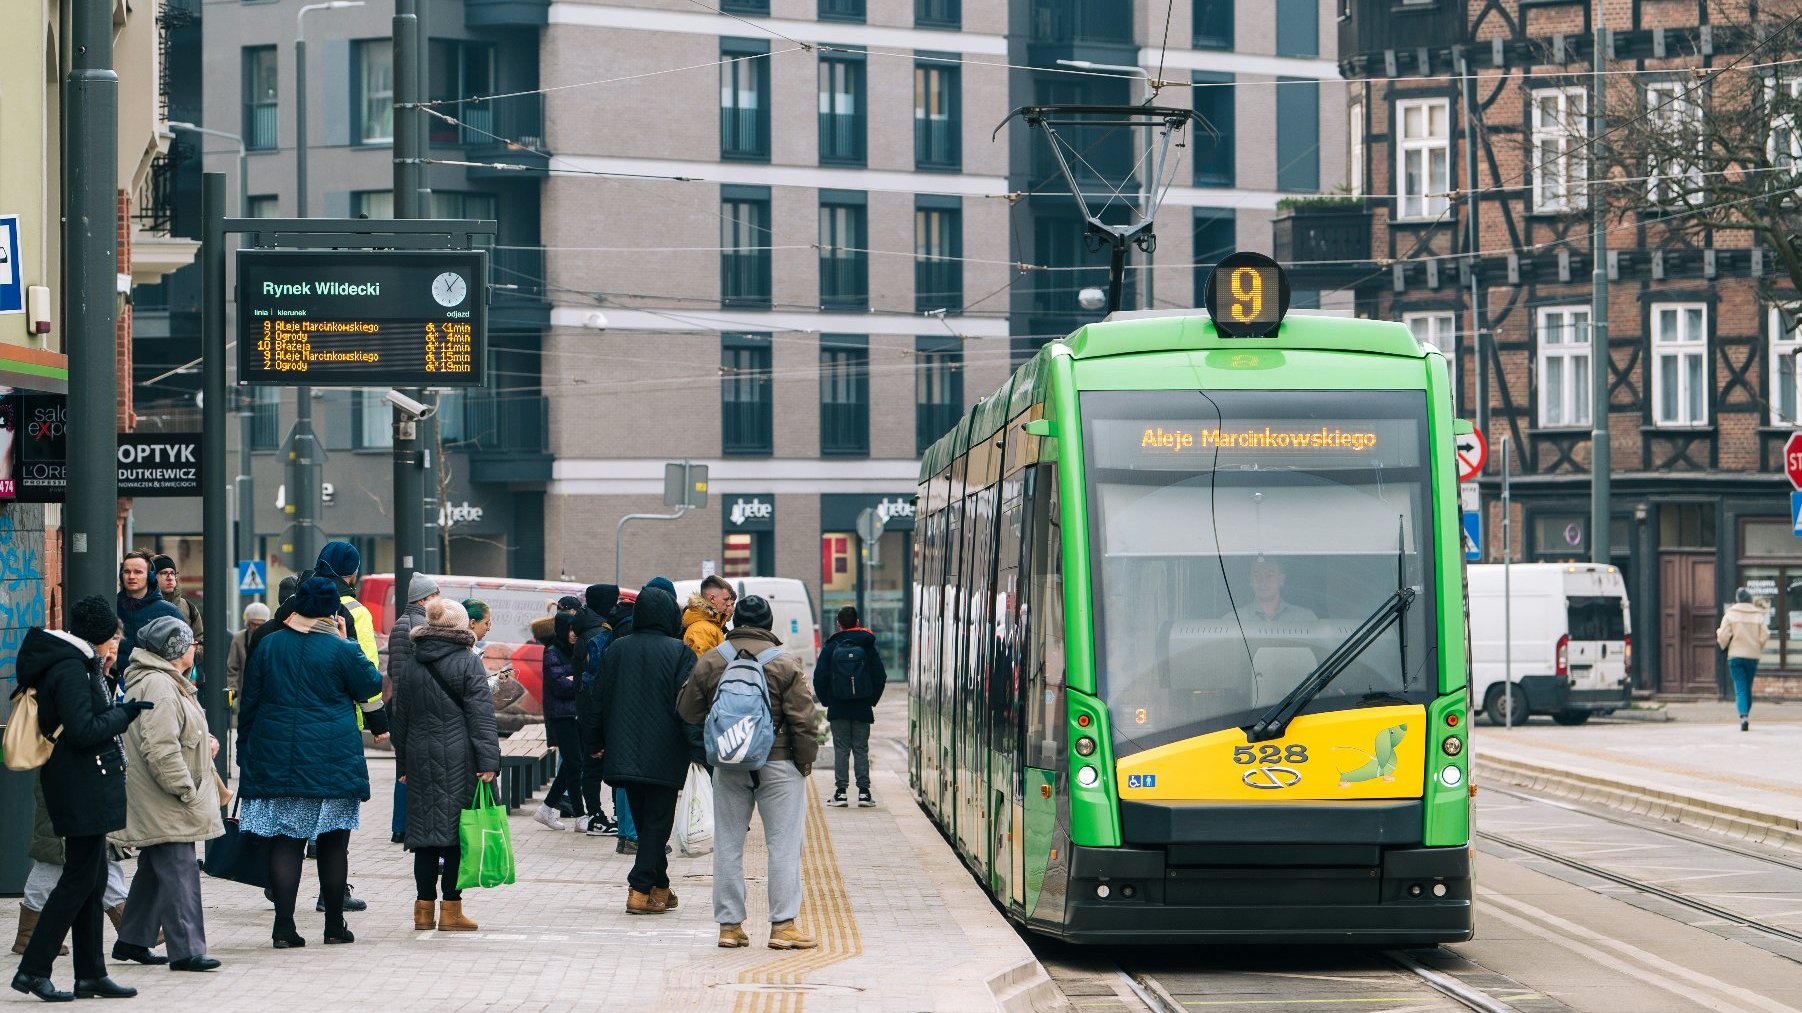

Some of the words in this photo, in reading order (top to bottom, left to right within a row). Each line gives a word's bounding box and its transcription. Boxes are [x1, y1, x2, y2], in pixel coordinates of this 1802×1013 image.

[263, 281, 311, 298] Rynek
[315, 281, 380, 296] Wildecki
[1231, 267, 1262, 322] 9
[446, 310, 470, 318] odjazd
[263, 320, 271, 331] 9
[275, 320, 300, 332] Aleje
[302, 321, 379, 333] Marcinkowskiego
[441, 322, 471, 333] <1min
[263, 330, 271, 341] 2
[275, 330, 308, 342] Ogrody
[446, 332, 471, 343] 4min
[257, 340, 271, 351] 10
[275, 339, 311, 351] Błażeja
[440, 342, 471, 352] 11min
[263, 350, 271, 361] 9
[275, 350, 300, 362] Aleje
[302, 350, 379, 363] Marcinkowskiego
[440, 352, 471, 362] 15min
[263, 360, 271, 370] 2
[275, 360, 308, 372] Ogrody
[440, 362, 471, 372] 19min
[28, 421, 67, 441] exp
[1141, 428, 1193, 452] Aleje
[1201, 428, 1377, 451] Marcinkowskiego
[117, 444, 196, 463] OPTYK
[118, 468, 196, 479] DUTKIEWICZ
[738, 498, 772, 518] hebe
[1135, 708, 1147, 724] 3
[717, 715, 754, 758] NIKE
[1233, 744, 1309, 765] 528
